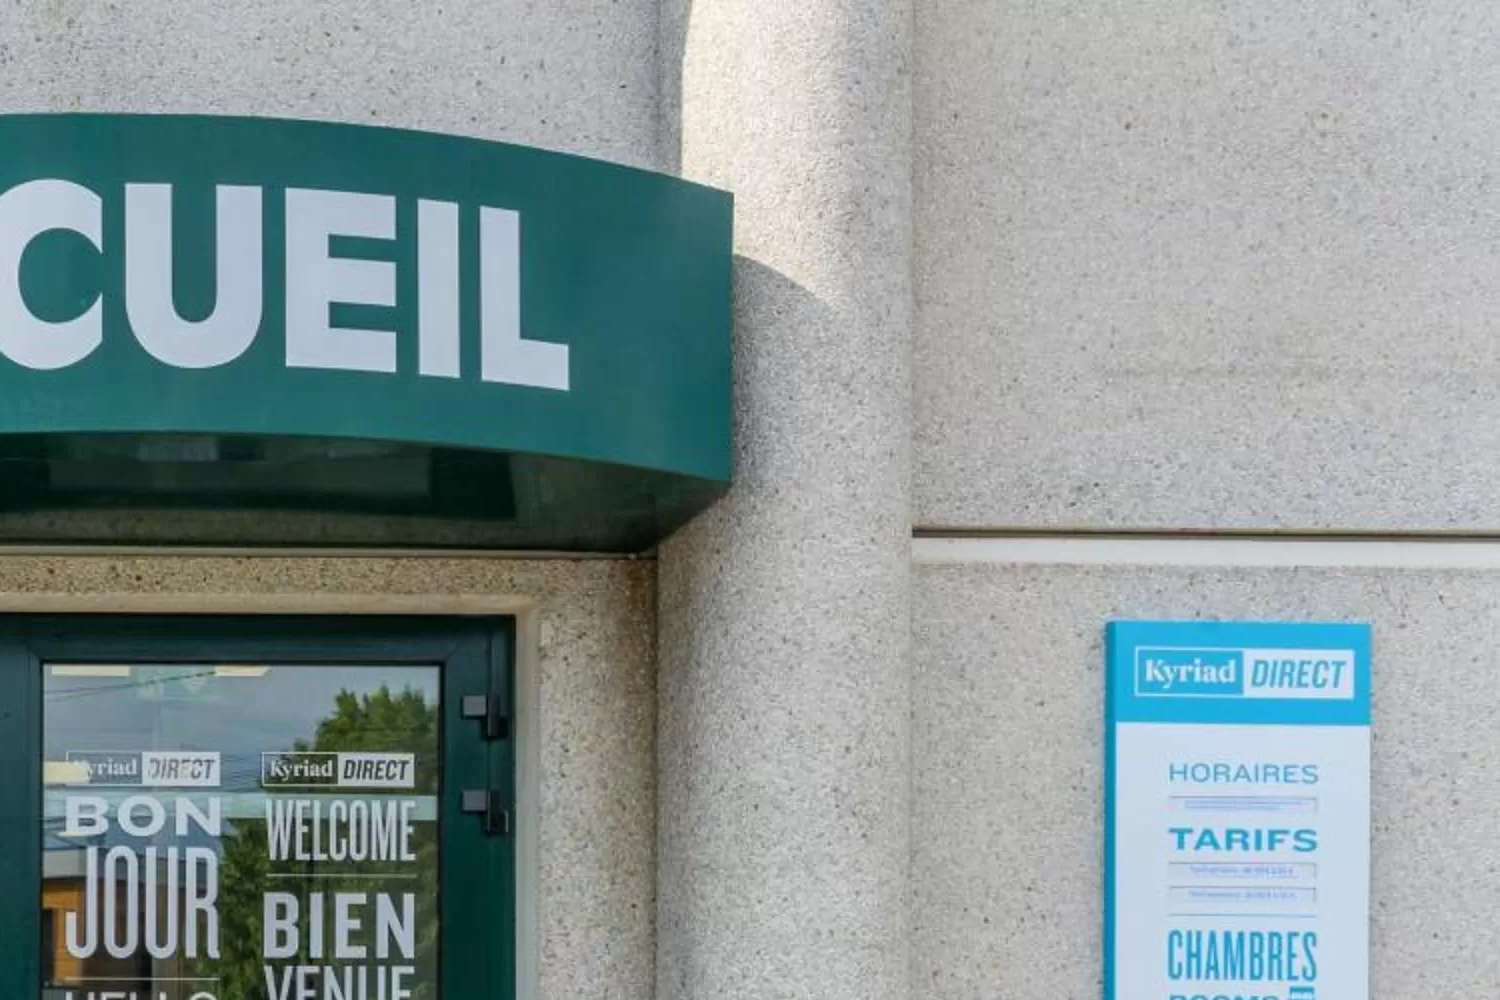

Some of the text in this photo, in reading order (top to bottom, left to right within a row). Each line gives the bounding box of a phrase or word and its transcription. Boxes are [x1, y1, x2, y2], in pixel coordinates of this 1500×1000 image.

[1144, 658, 1347, 689] Kyriad DIRECT
[73, 757, 215, 781] yriad DIRECT
[270, 759, 410, 782] Kyriad DIRECT
[1168, 763, 1319, 785] HORAIRES
[65, 795, 221, 838] BON
[265, 799, 417, 862] WELCOME
[1168, 827, 1318, 852] TARIFS
[65, 845, 221, 959] JOUR
[263, 892, 415, 959] BIEN
[1167, 929, 1318, 982] CHAMBRES
